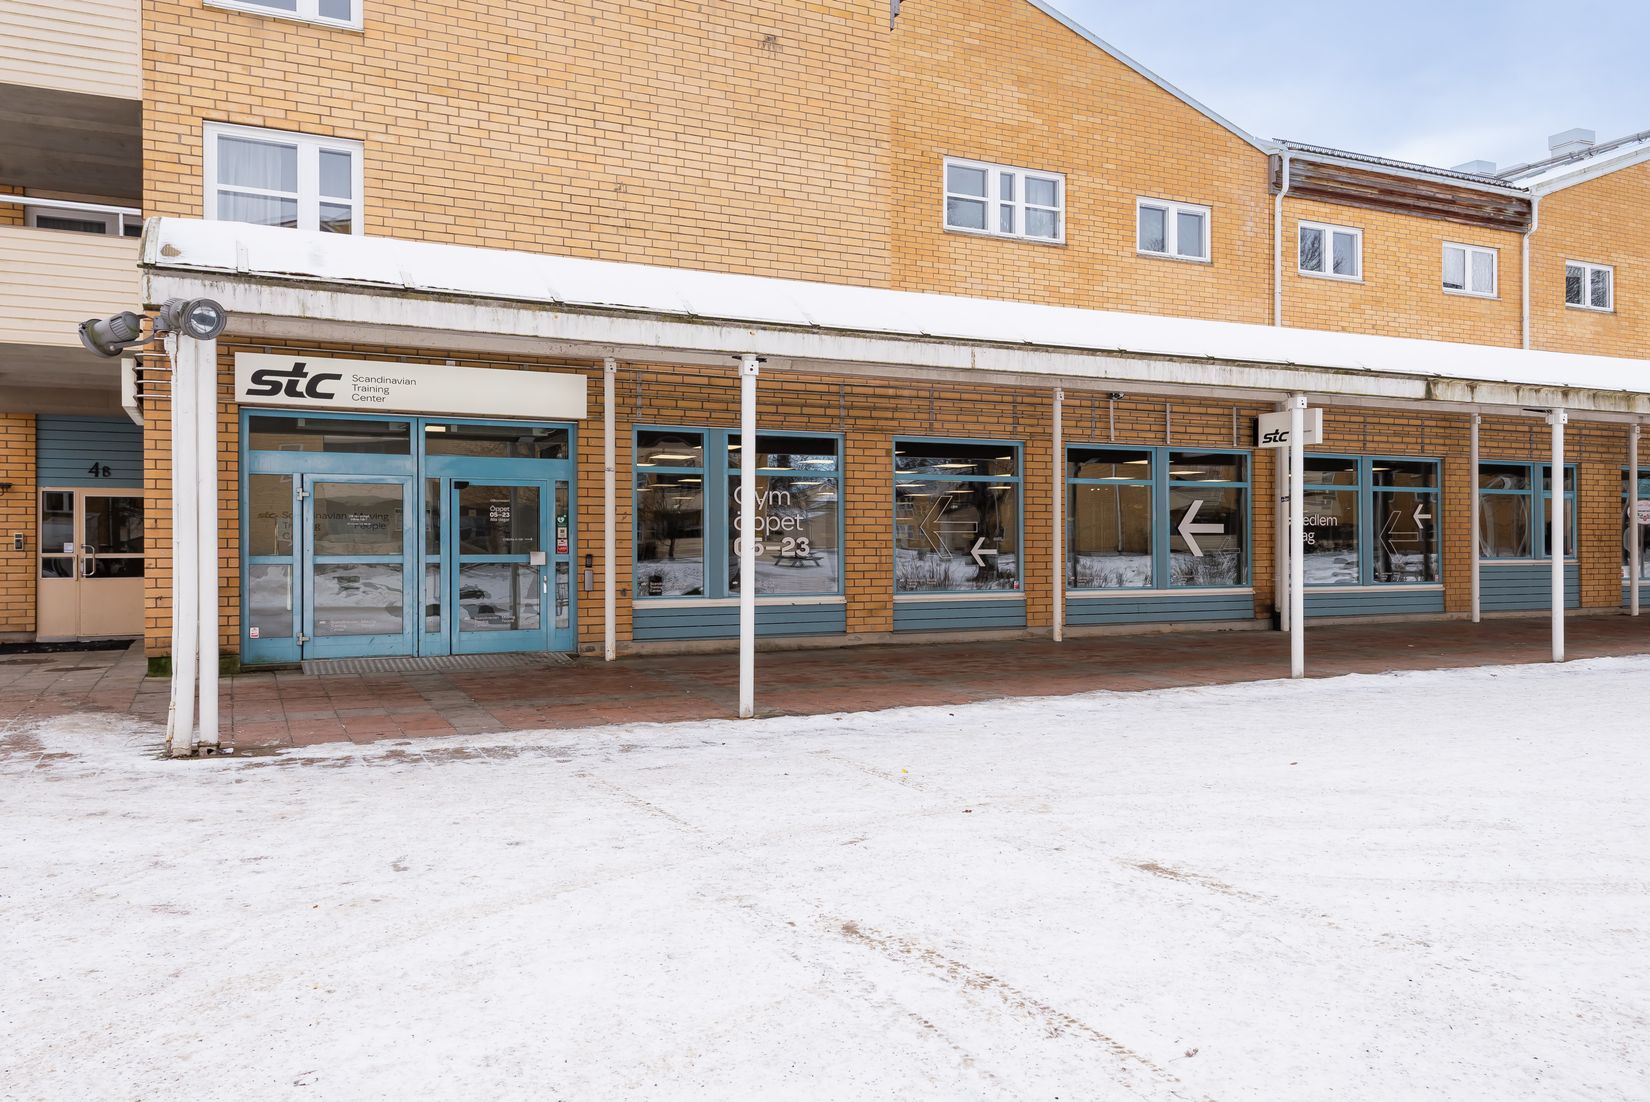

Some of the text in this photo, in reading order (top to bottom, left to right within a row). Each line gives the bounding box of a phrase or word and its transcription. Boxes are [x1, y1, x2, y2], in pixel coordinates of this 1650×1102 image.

[245, 361, 343, 400] stc
[351, 374, 417, 386] Scandinavian
[351, 384, 390, 396] Training
[351, 394, 386, 403] Center
[1262, 429, 1290, 444] stc
